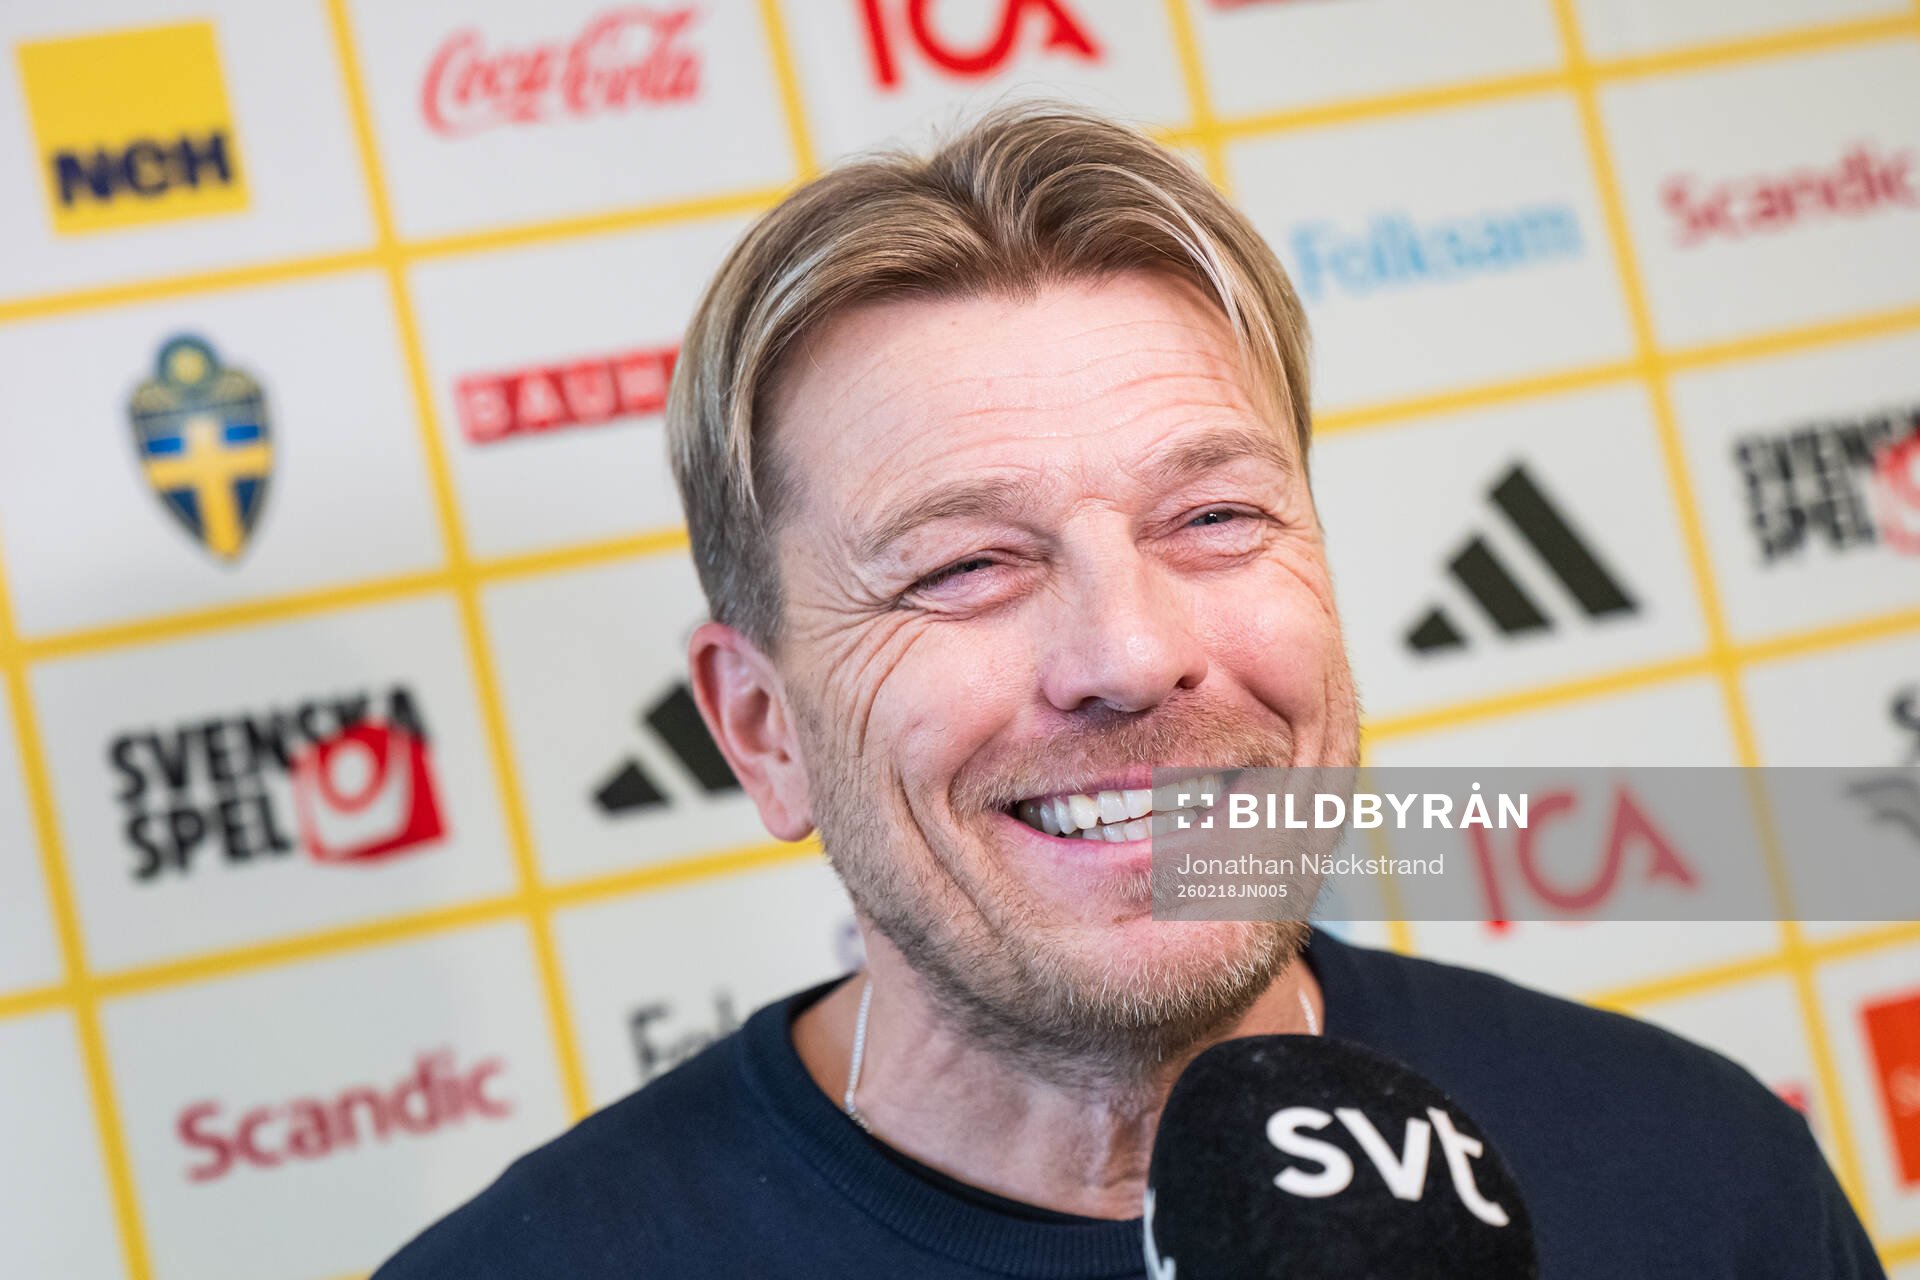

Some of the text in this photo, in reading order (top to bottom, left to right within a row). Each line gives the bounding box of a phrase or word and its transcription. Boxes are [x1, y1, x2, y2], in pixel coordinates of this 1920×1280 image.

[1292, 206, 1584, 302] Folksam
[111, 688, 430, 804] SVENSKA
[129, 796, 294, 880] SPEL
[177, 1048, 512, 1184] Scandic
[1266, 1106, 1510, 1227] svt
